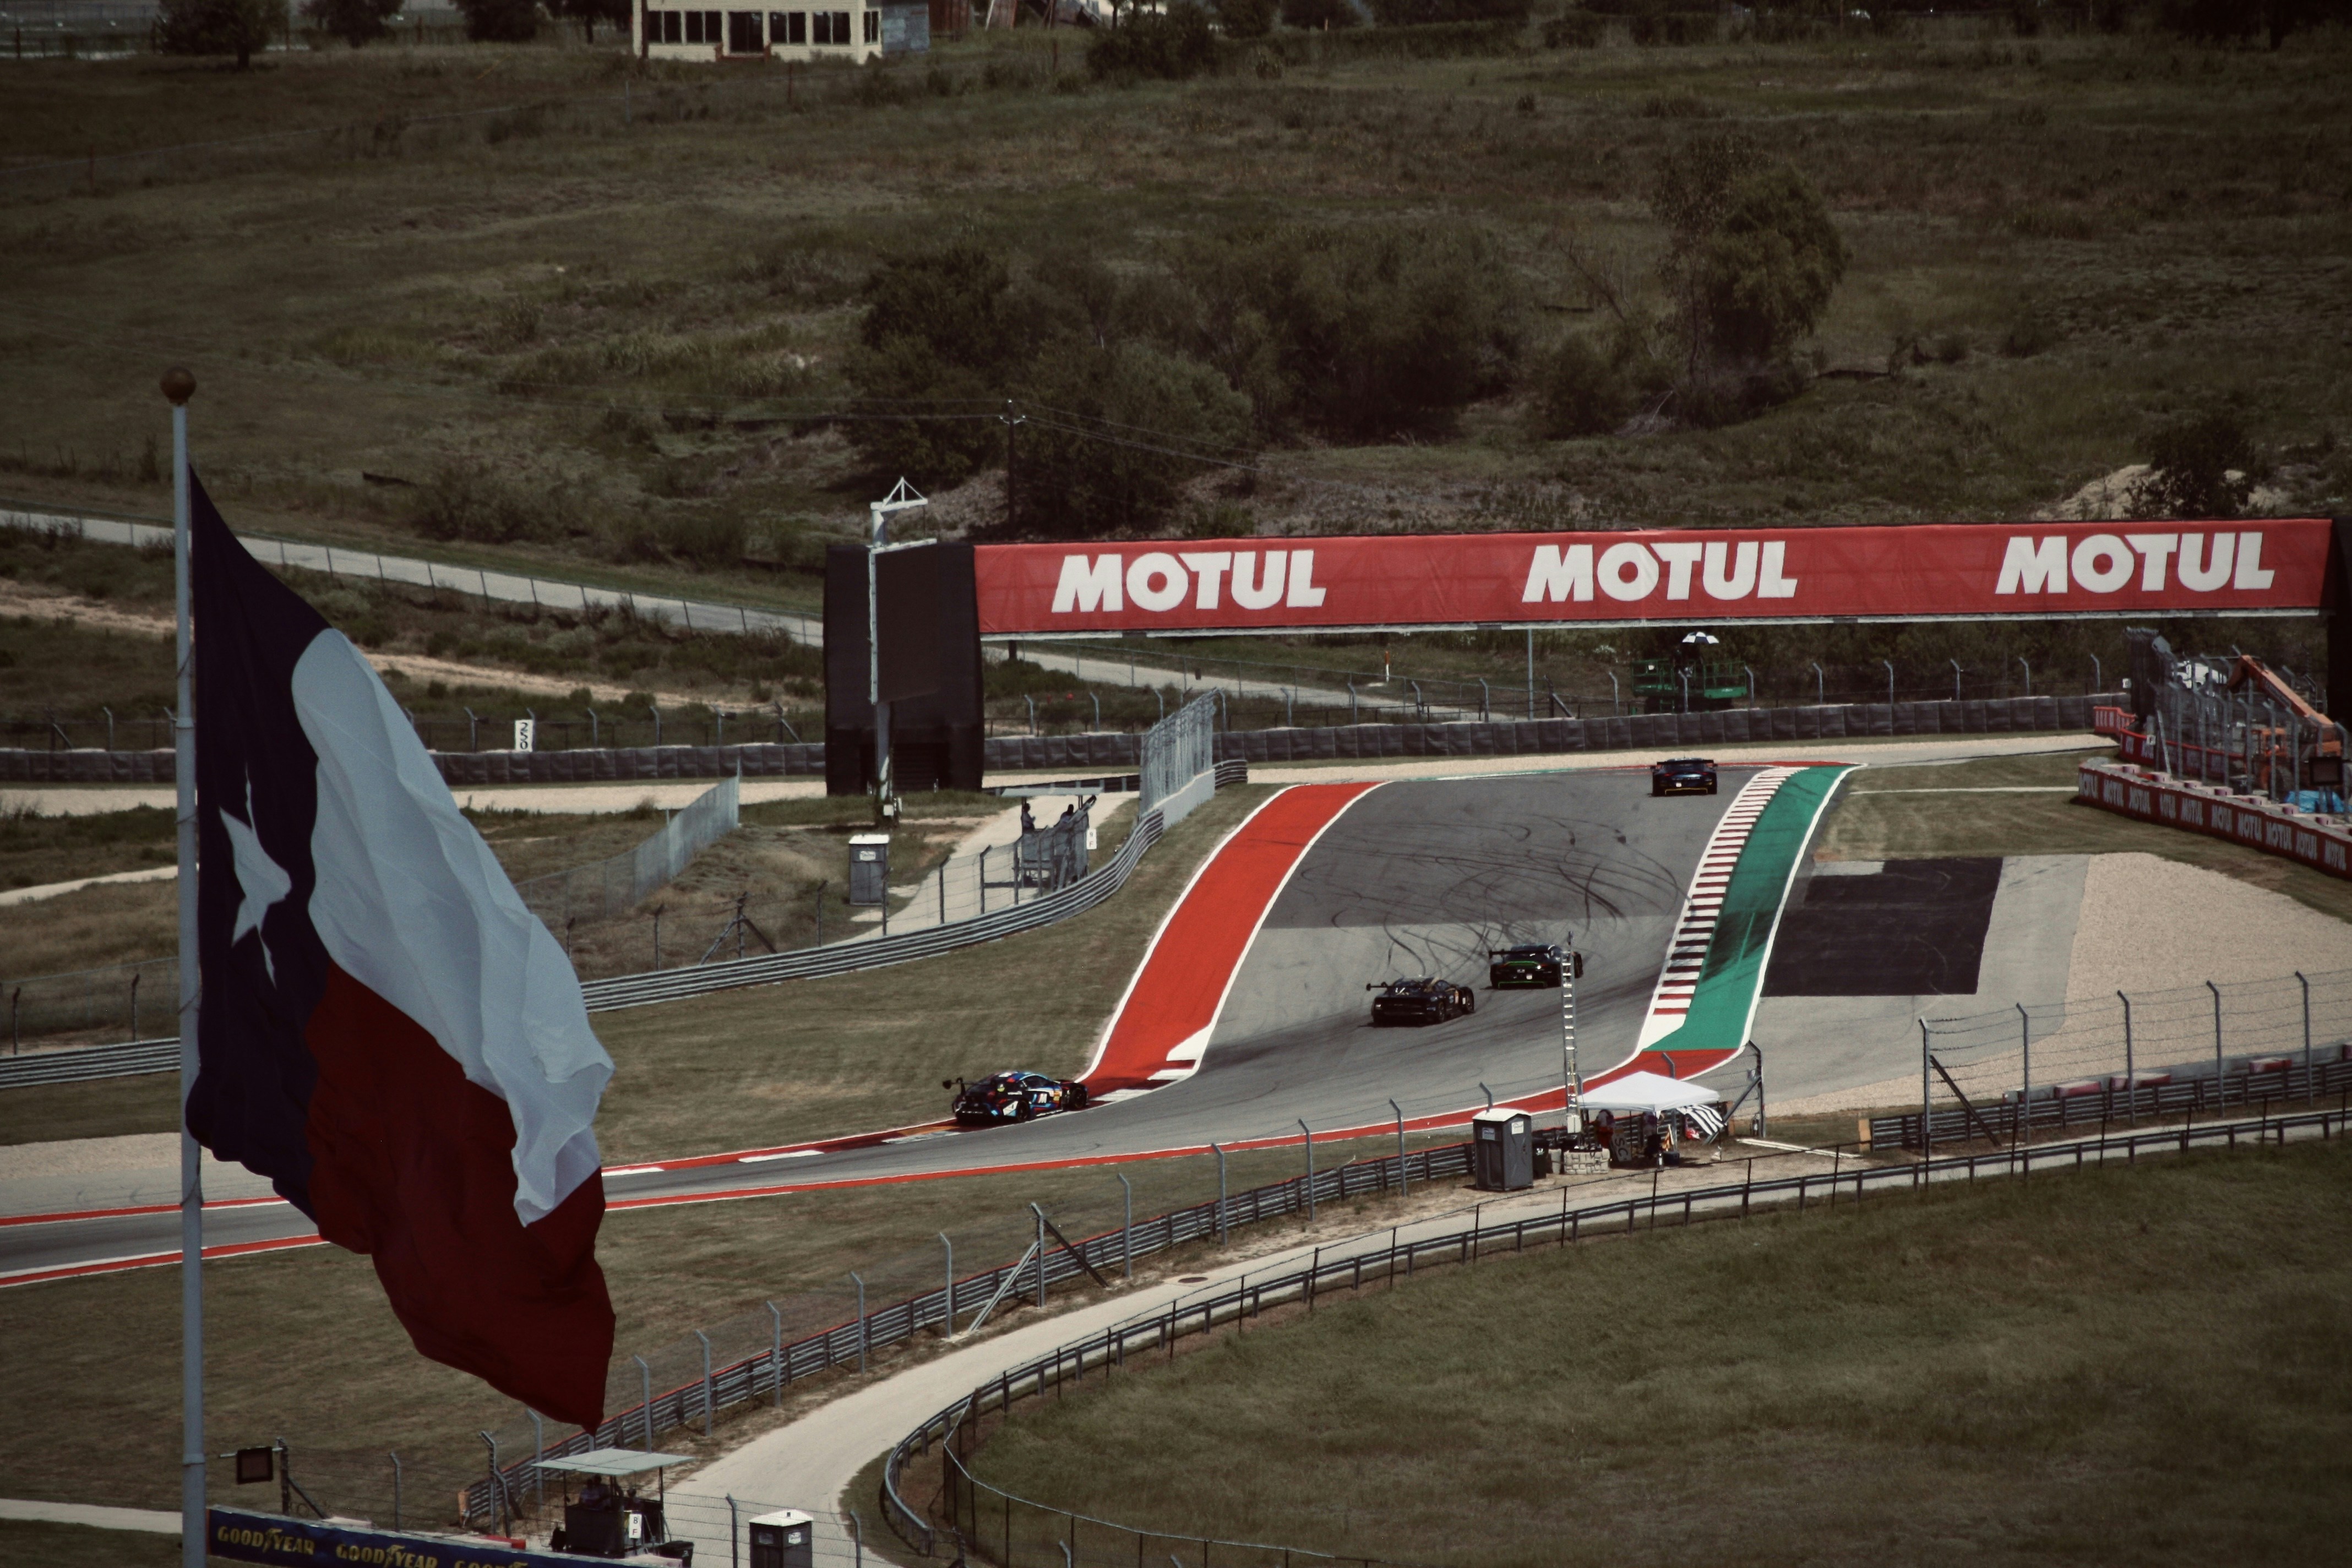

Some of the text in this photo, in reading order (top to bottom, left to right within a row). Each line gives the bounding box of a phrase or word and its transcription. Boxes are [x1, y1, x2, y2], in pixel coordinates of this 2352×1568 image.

[1051, 532, 2274, 613] MOTUL MOTUL MOTUL
[520, 722, 529, 749] 250
[217, 1526, 438, 1568] GOODYEAR GOODYEAR
